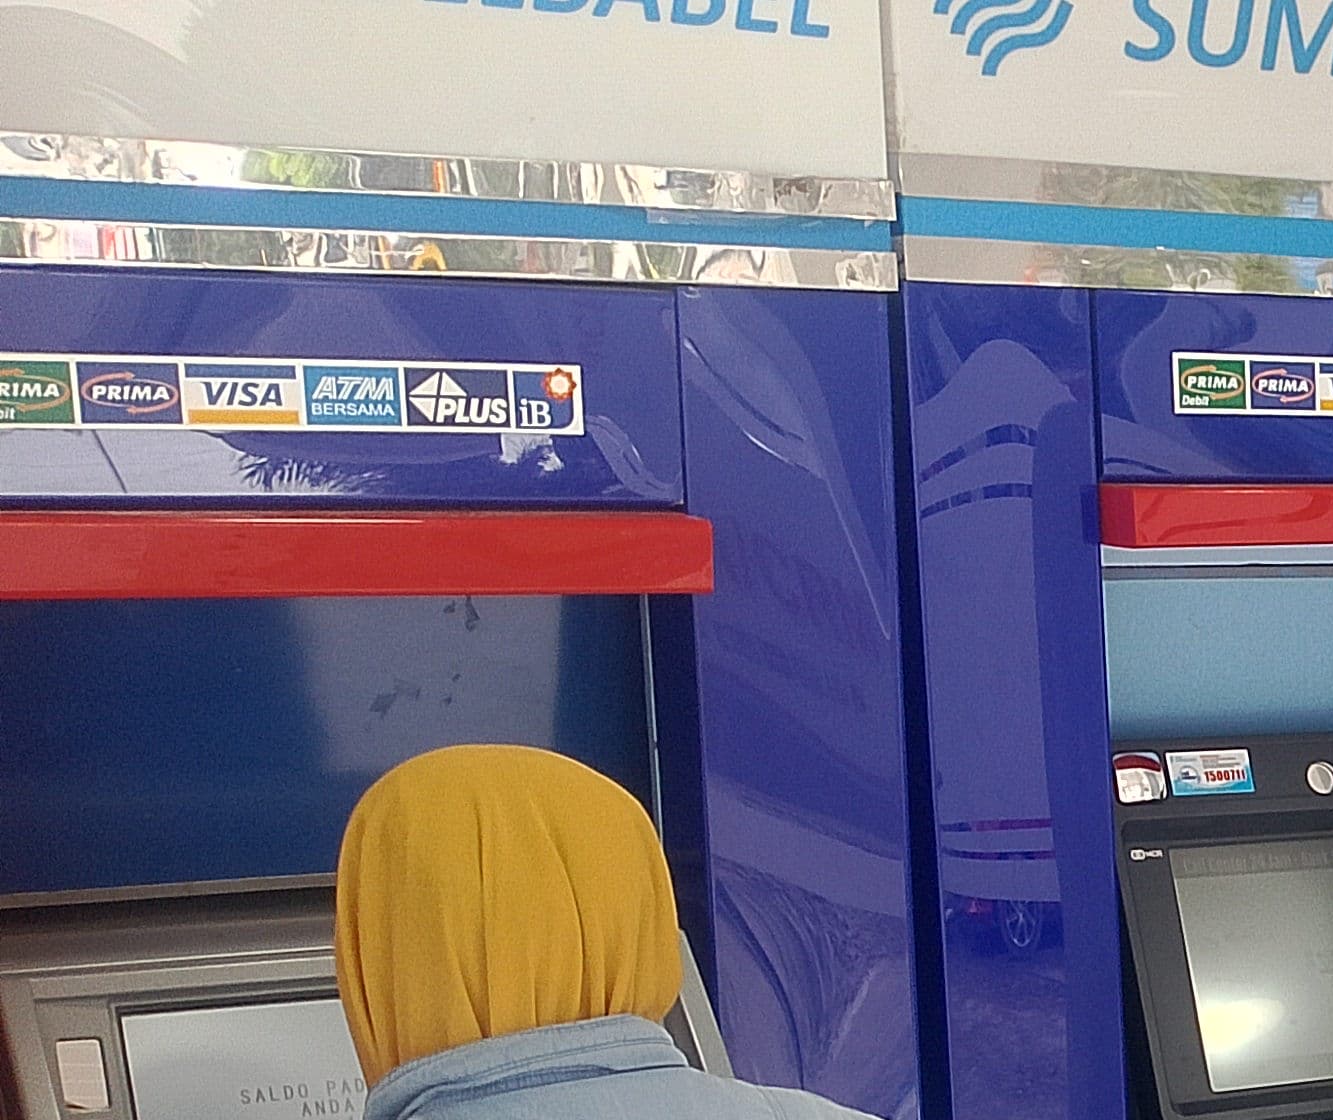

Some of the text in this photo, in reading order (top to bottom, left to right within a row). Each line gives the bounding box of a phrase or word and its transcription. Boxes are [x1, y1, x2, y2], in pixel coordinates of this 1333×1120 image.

[0, 382, 60, 398] RIMA
[312, 376, 395, 400] ATM
[1187, 376, 1239, 389] PRIMA
[1258, 379, 1309, 393] PRIMA
[92, 385, 170, 401] PRIMA
[200, 381, 283, 406] VISA
[1182, 395, 1209, 406] Debit
[312, 402, 395, 417] BERSAMA
[436, 397, 507, 424] PLUS
[519, 400, 552, 427] iB
[1204, 769, 1246, 783] 1500711
[241, 1078, 364, 1105] SALDO PAD
[302, 1100, 354, 1117] ANDA
